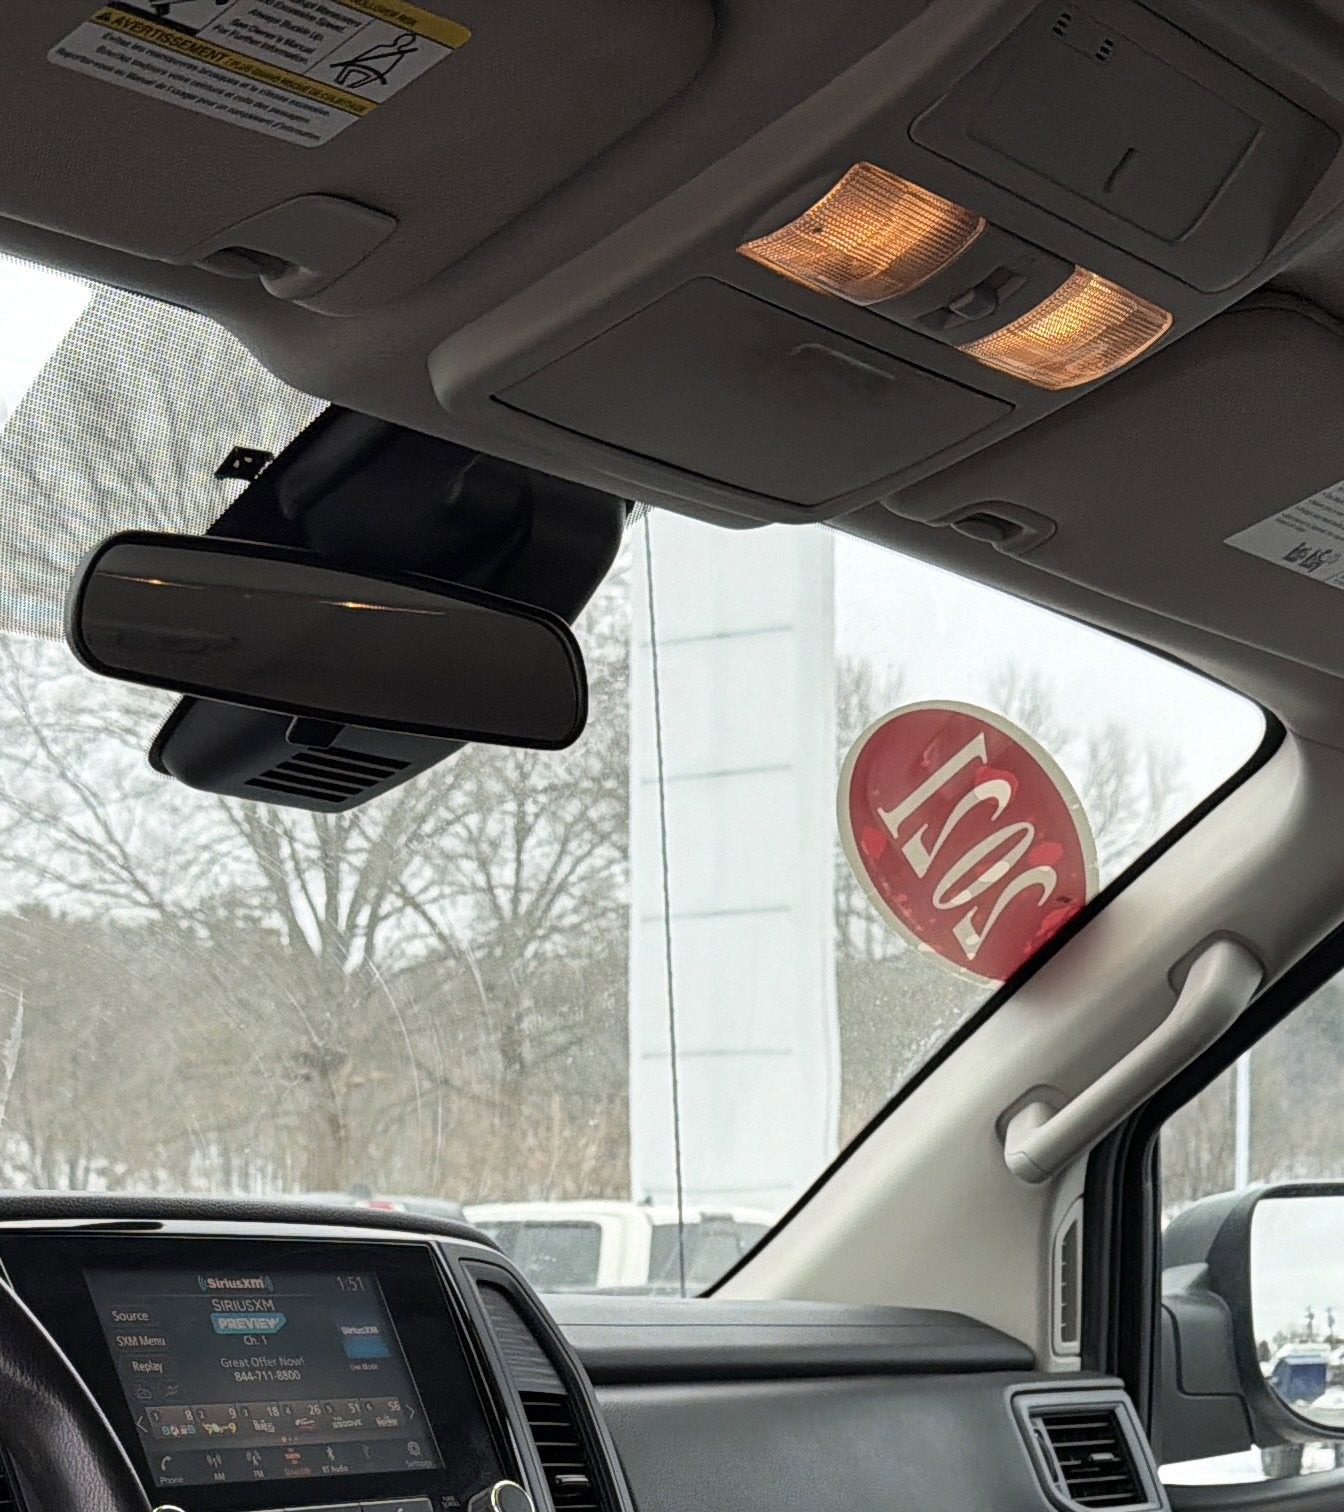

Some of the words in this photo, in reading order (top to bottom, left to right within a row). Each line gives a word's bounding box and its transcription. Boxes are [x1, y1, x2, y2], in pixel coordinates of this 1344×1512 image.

[108, 15, 230, 63] AVERTISSEMENT
[336, 1276, 366, 1291] 1:51
[211, 1299, 275, 1312] SIRIUSXM
[111, 1311, 150, 1322] Source
[218, 1318, 279, 1329] PREVIEW
[116, 1336, 137, 1346] SXM
[139, 1336, 166, 1346] Menu
[131, 1360, 164, 1373] Replay
[220, 1358, 249, 1368] Great
[250, 1357, 277, 1368] Offer
